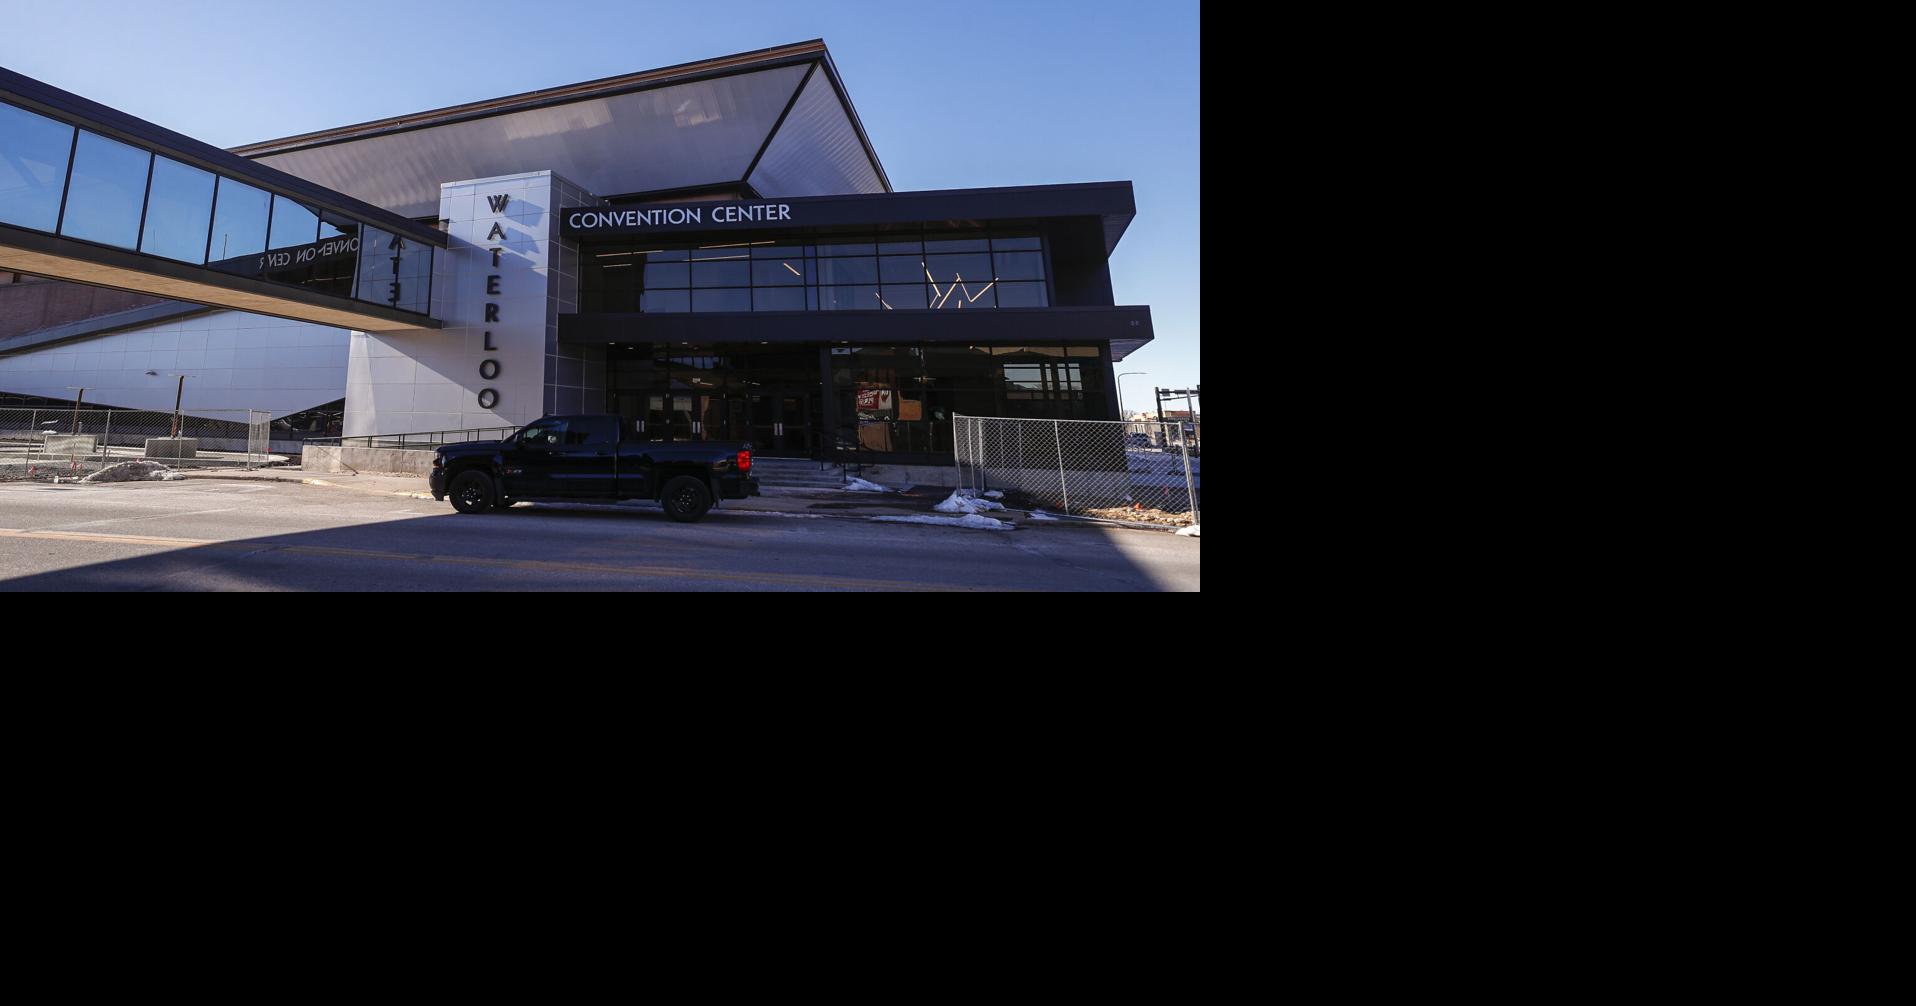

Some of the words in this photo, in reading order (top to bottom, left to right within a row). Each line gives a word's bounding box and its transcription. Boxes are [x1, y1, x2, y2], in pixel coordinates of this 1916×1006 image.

[569, 208, 701, 229] CONVENTION
[711, 204, 791, 223] CENTER
[478, 194, 509, 409] WATERLOO
